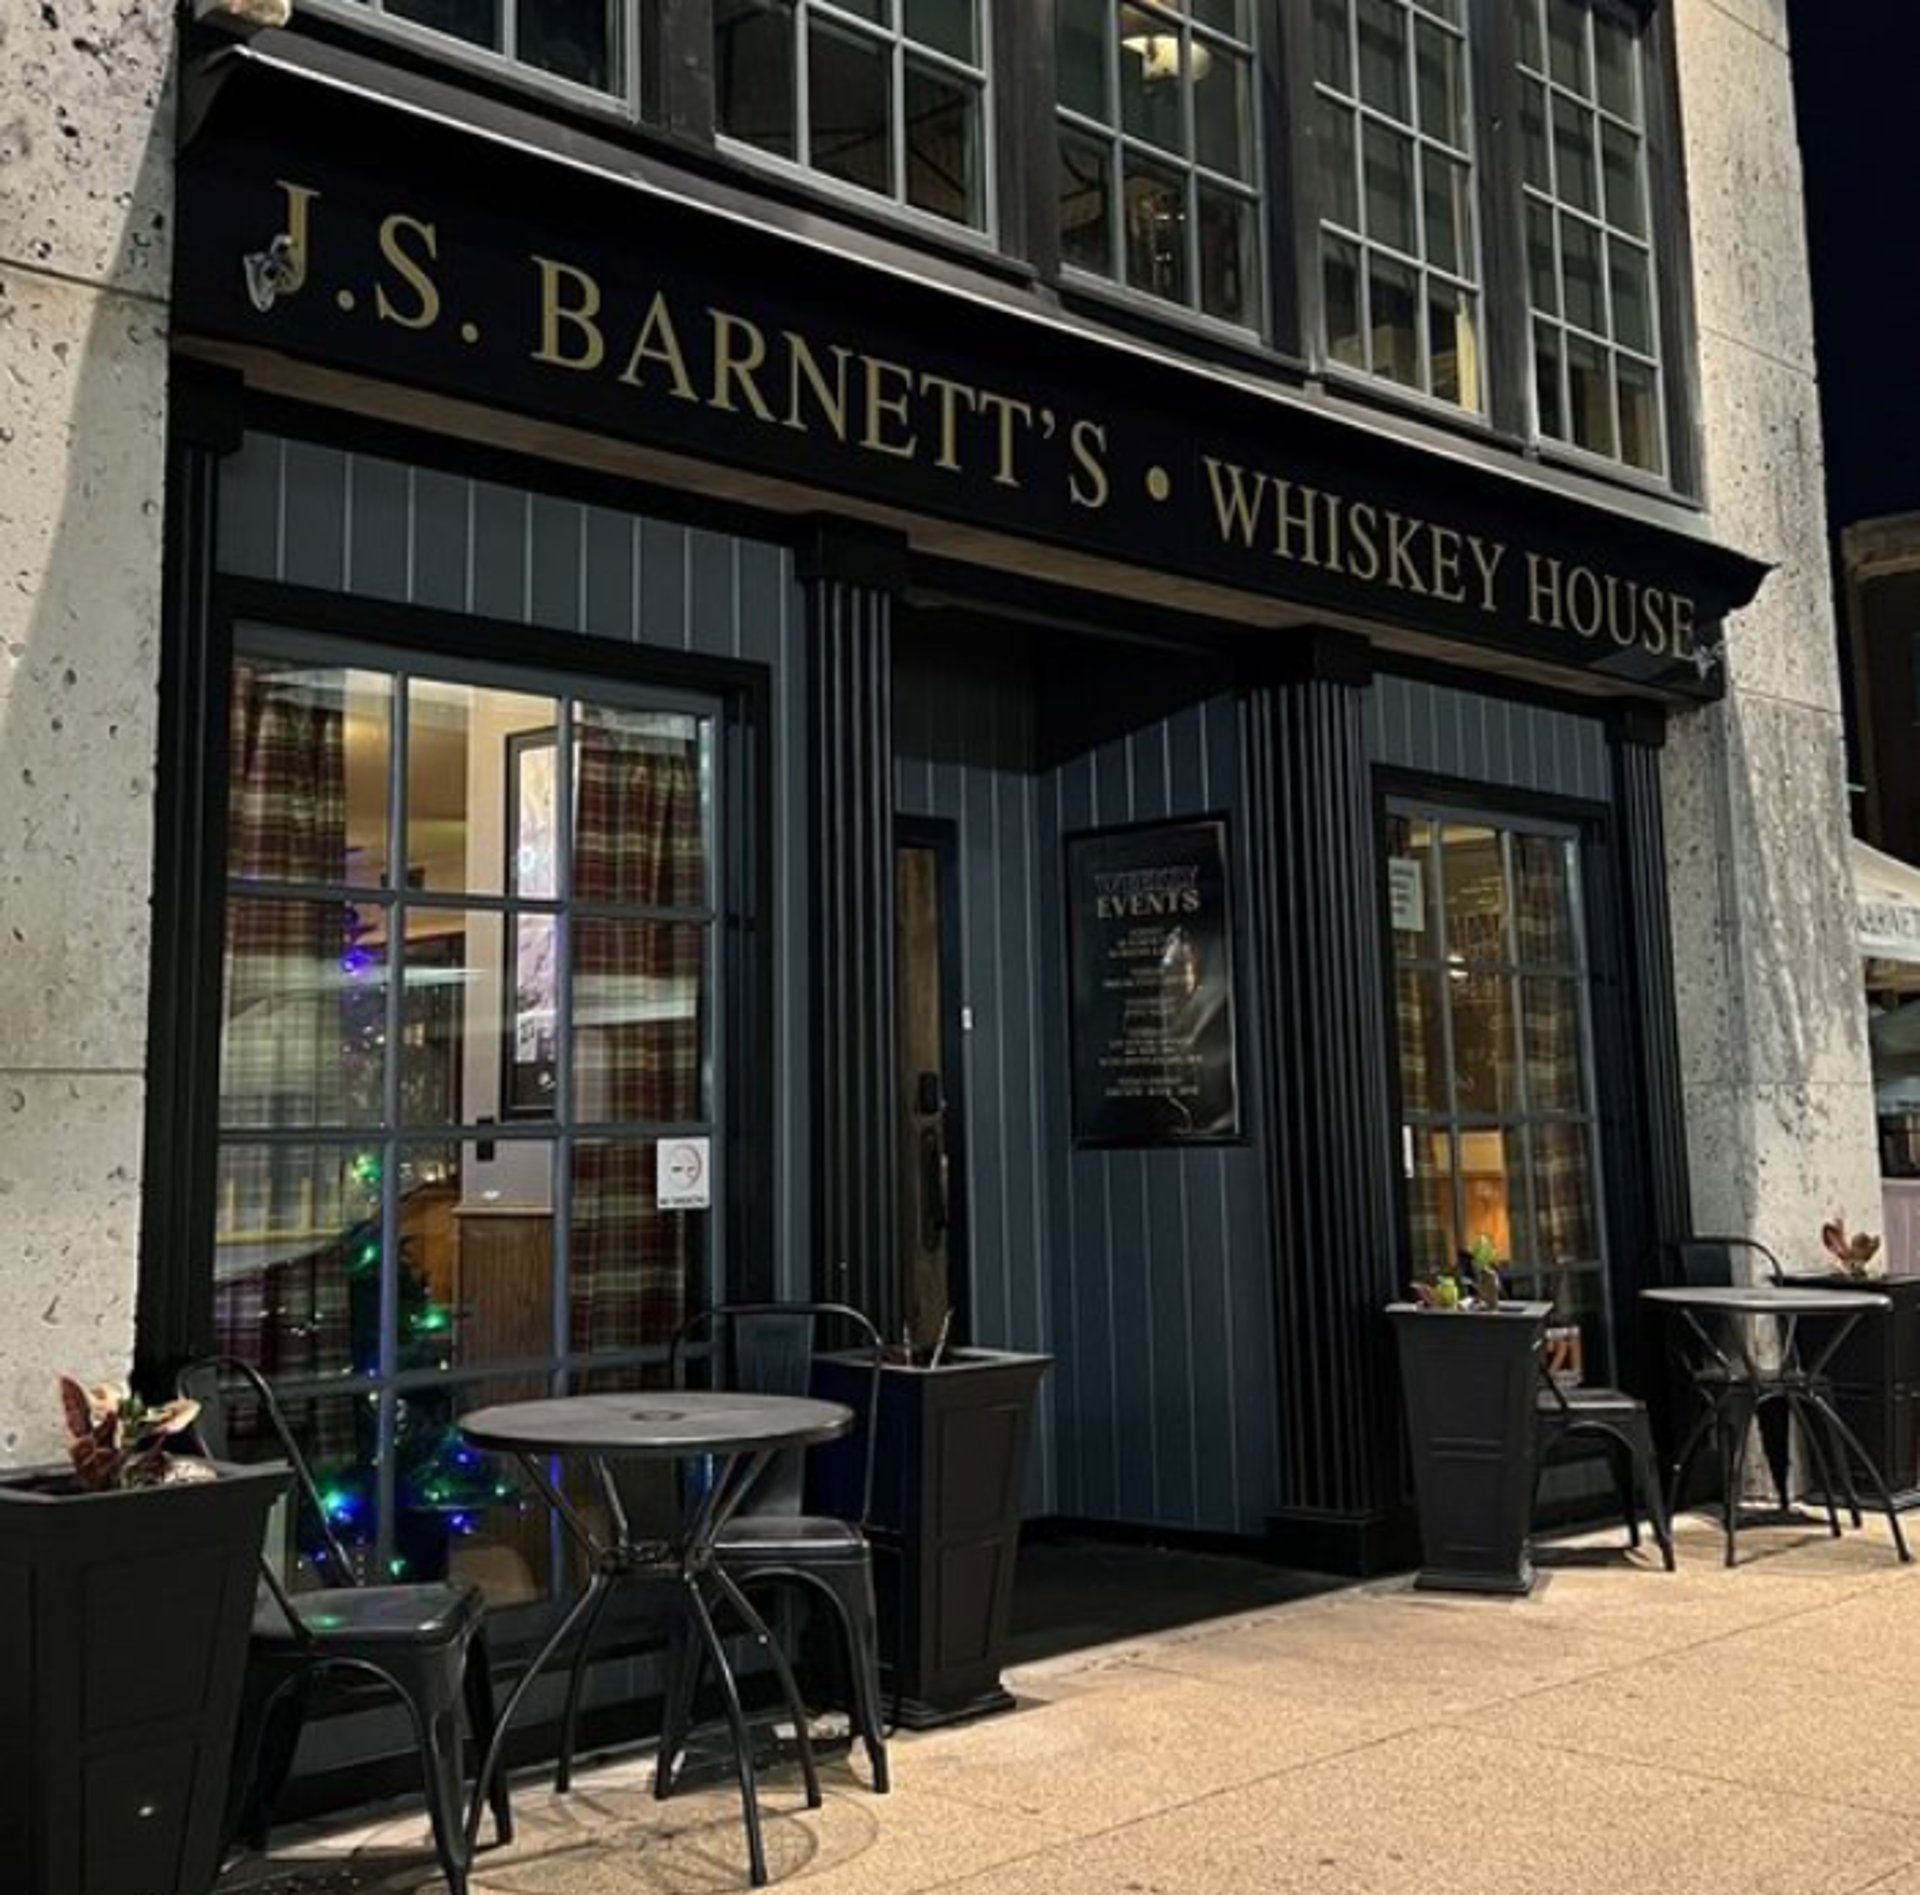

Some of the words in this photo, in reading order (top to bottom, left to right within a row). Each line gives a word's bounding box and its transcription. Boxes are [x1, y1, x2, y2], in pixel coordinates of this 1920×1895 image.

[268, 179, 479, 344] J.S.
[530, 254, 1110, 509] BARNETT'S
[1203, 455, 1506, 613] WHISKEY
[1524, 550, 1696, 662] HOUSE
[1096, 889, 1201, 919] EVENTS
